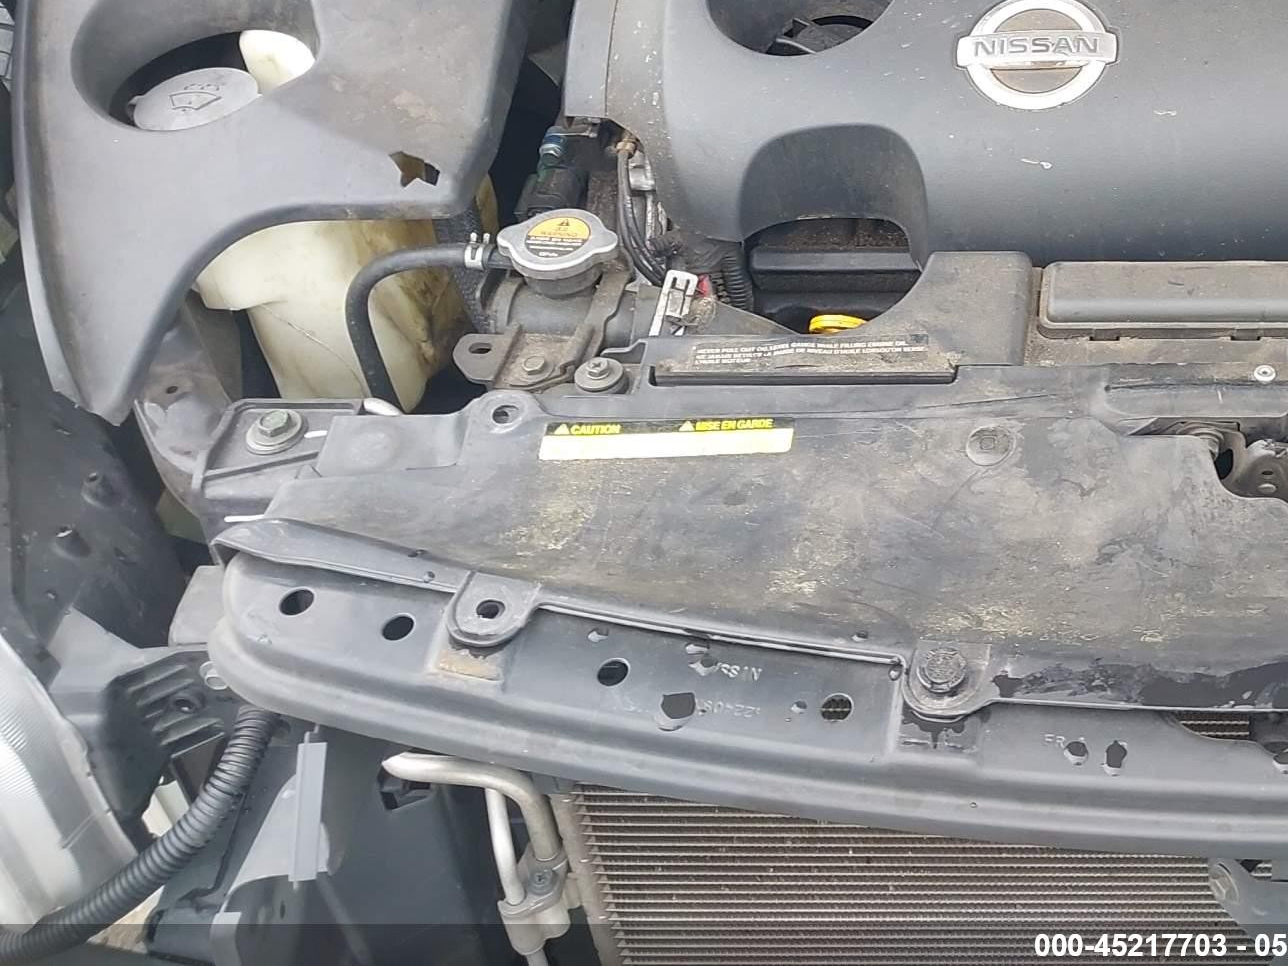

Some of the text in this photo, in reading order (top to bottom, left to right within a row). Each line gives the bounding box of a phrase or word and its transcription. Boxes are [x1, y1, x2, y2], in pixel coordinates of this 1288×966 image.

[973, 36, 1099, 57] NISSAN
[570, 418, 774, 435] CAUTION MISE EN GARDE
